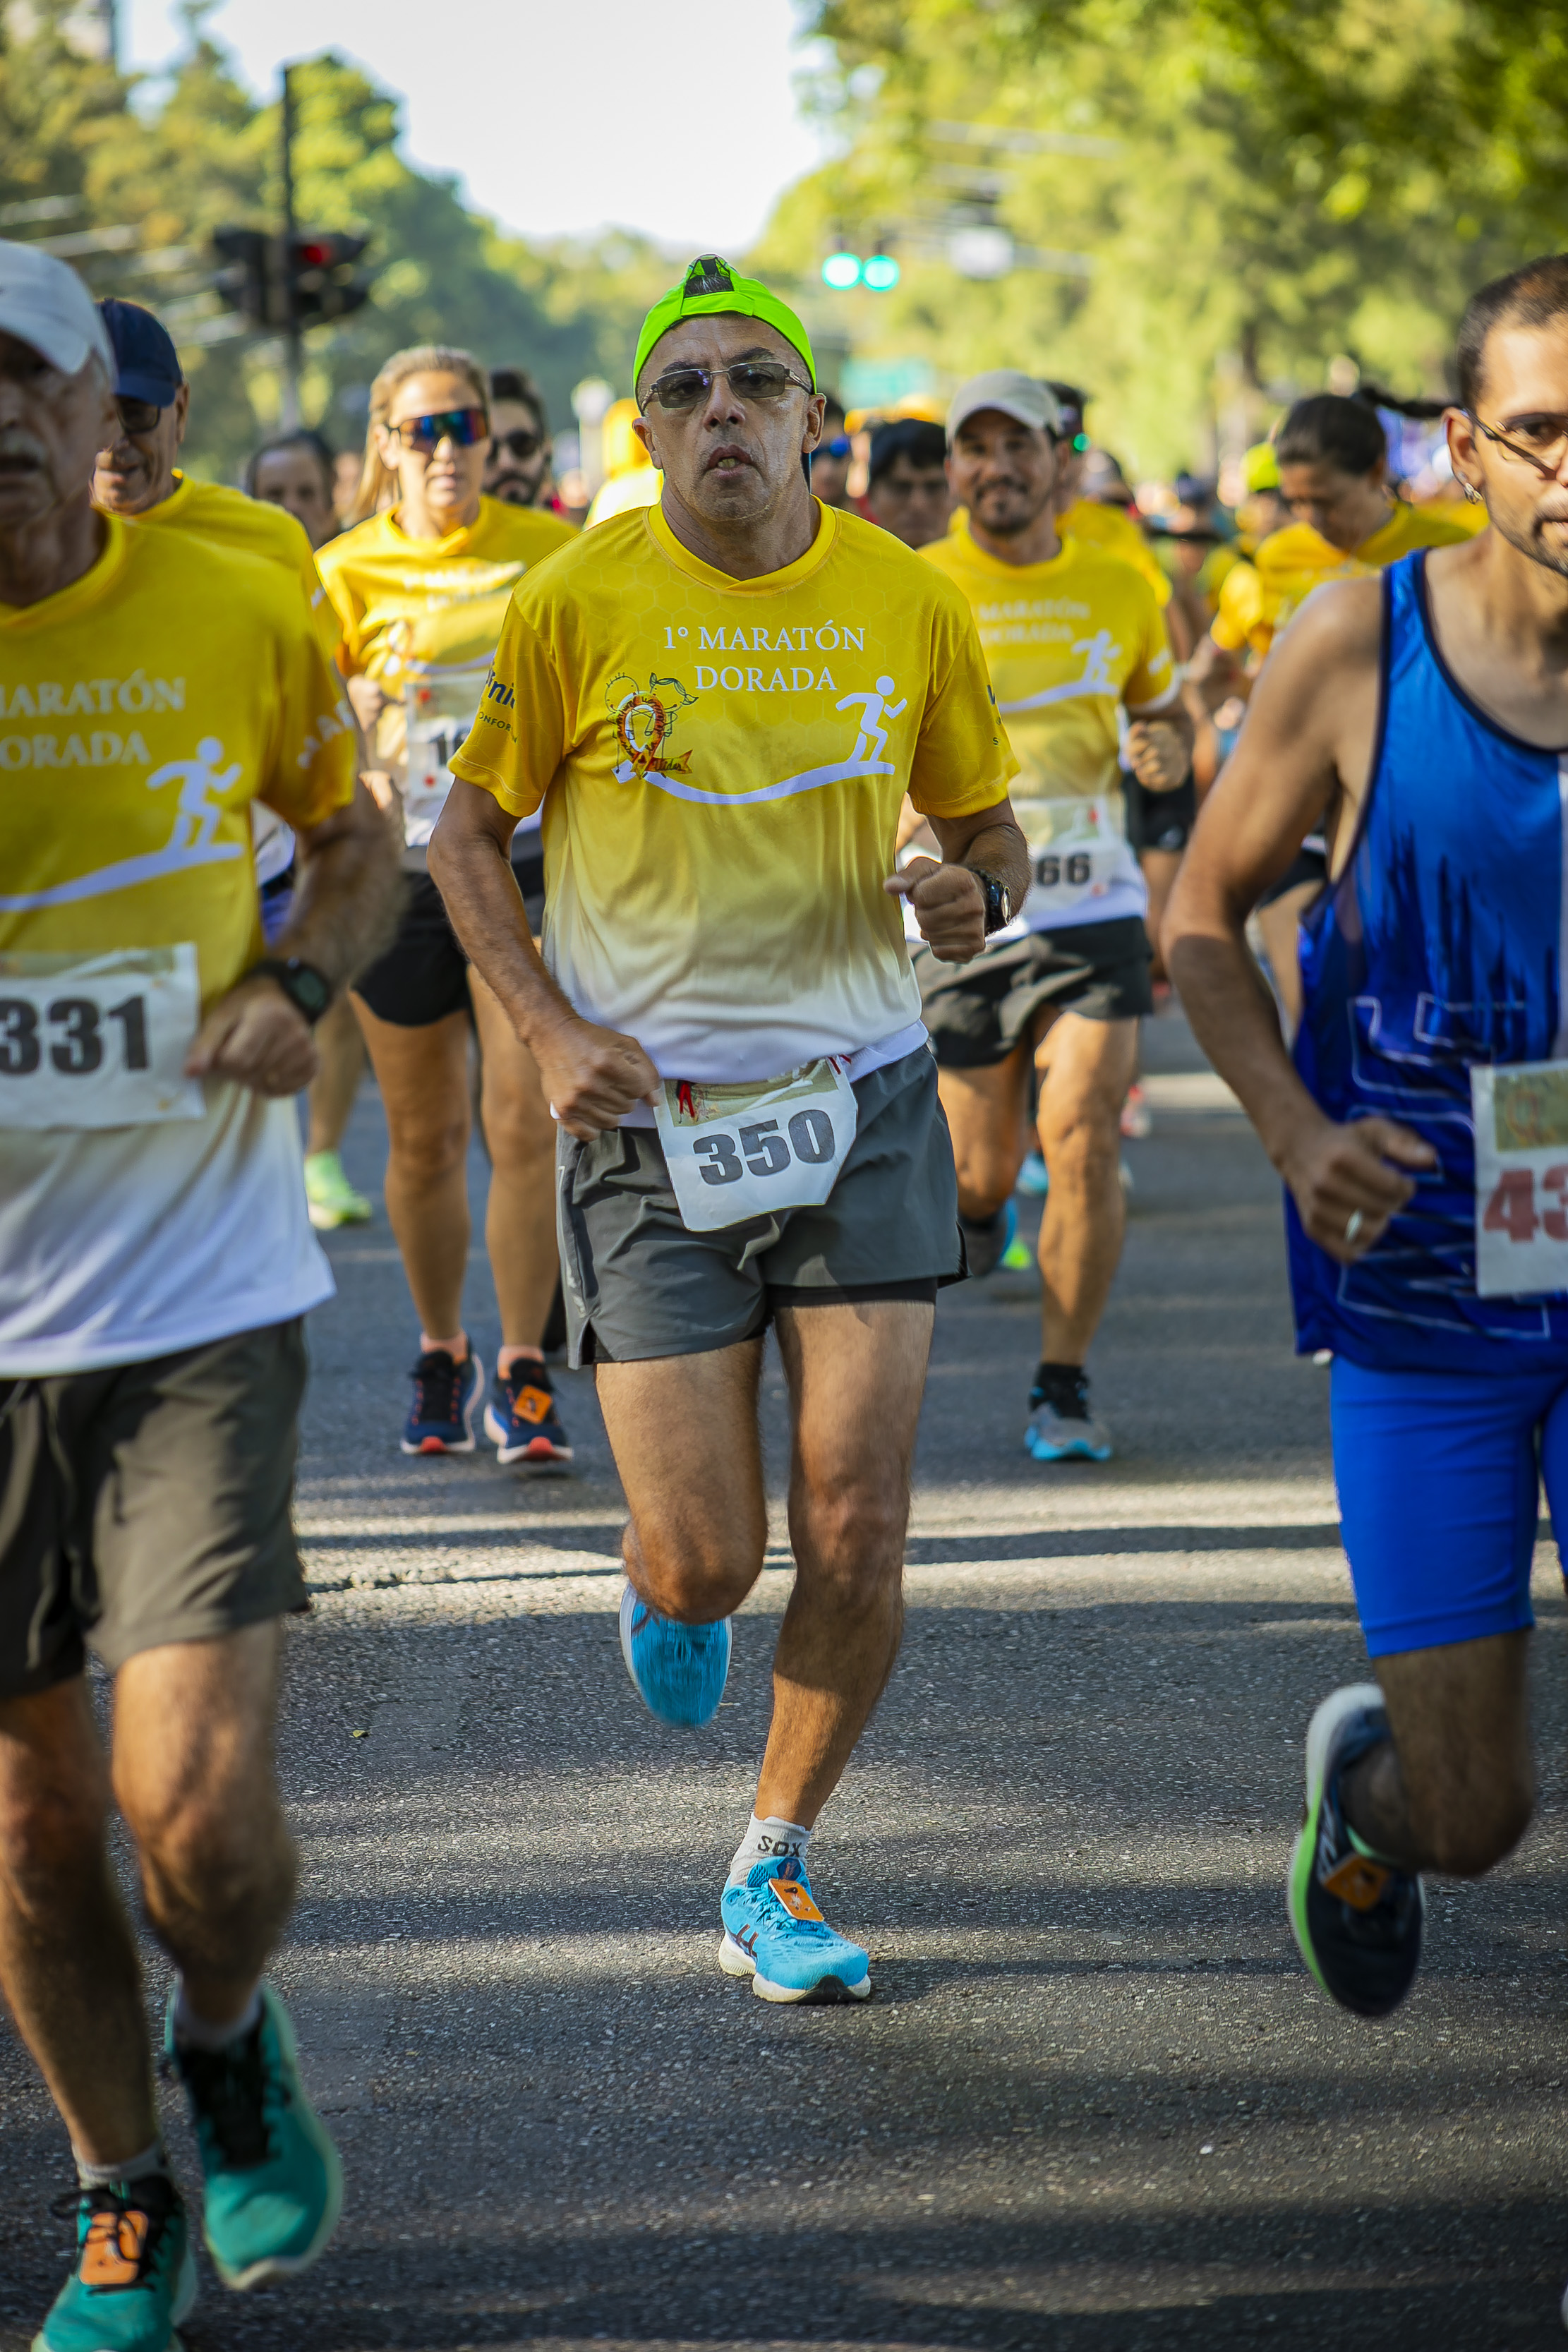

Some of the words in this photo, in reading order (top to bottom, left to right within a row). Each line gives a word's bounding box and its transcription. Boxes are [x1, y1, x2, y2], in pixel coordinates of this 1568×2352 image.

[697, 619, 867, 651] MARATÓN
[0, 668, 186, 718] ARATÓN
[694, 665, 838, 692] DORADA
[0, 995, 147, 1075] 331
[693, 1109, 836, 1186] 350
